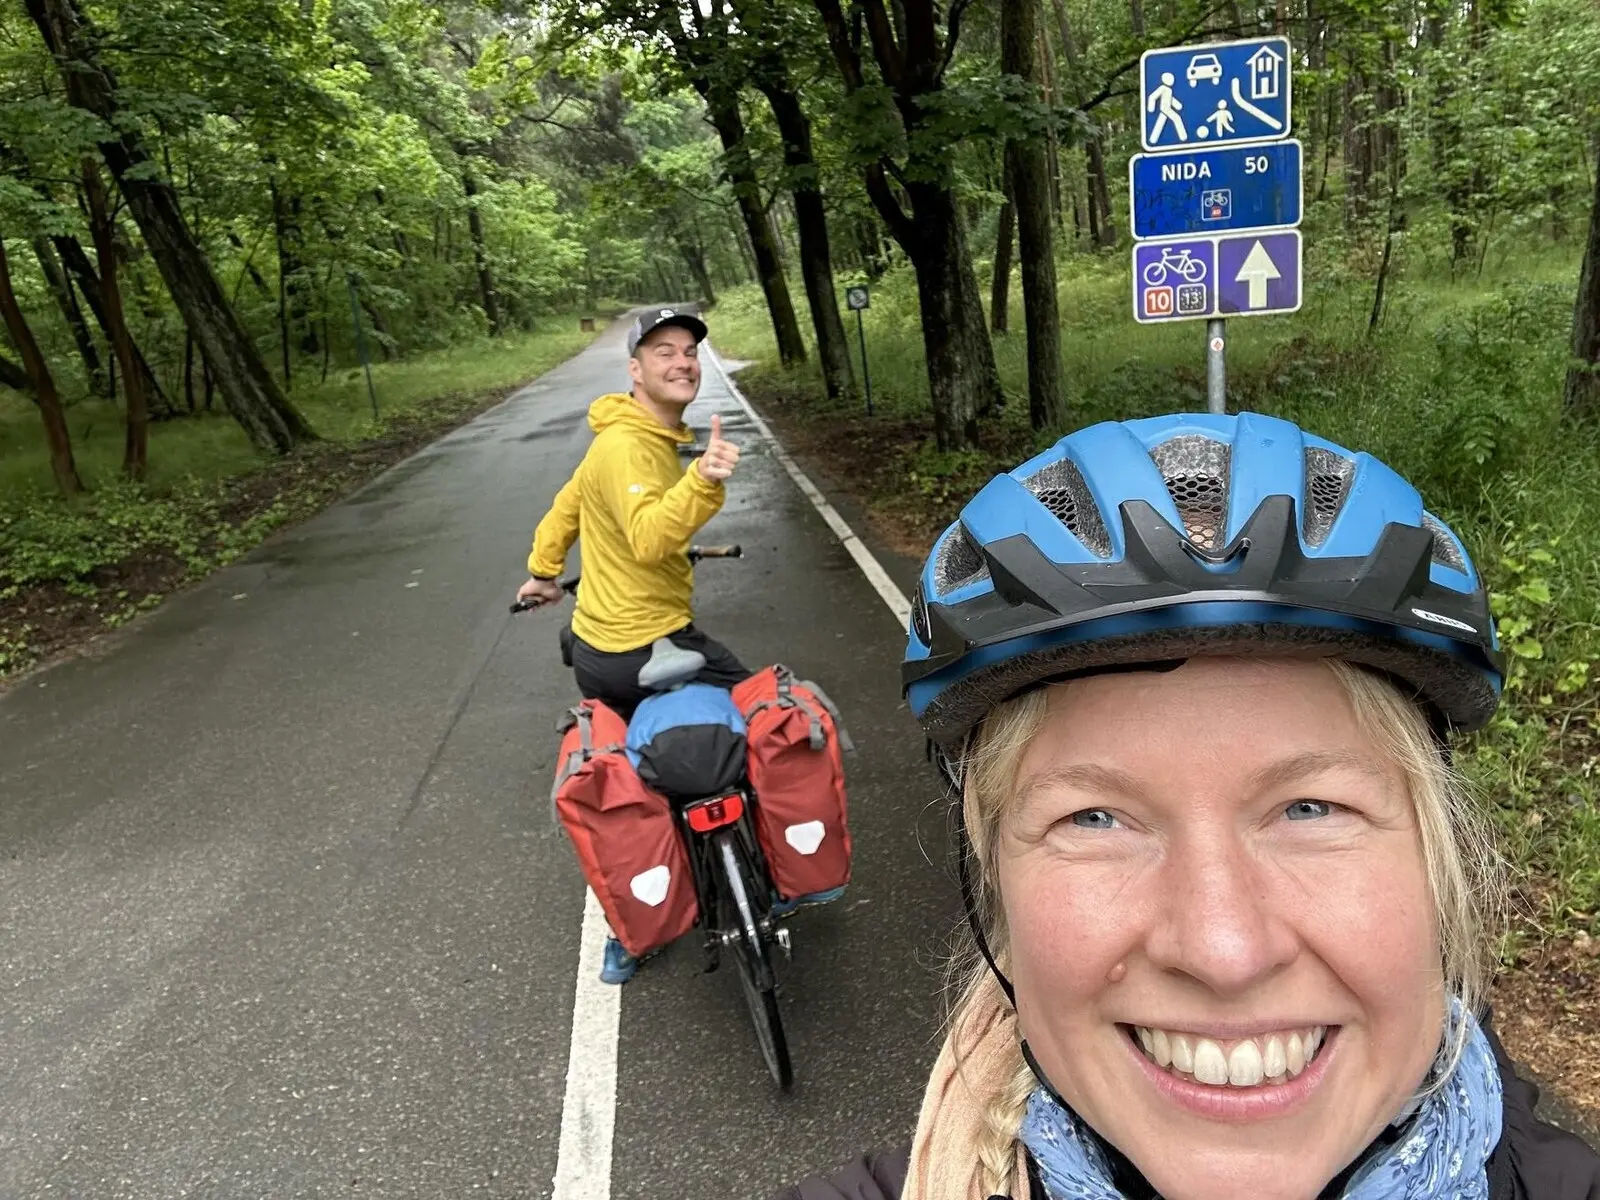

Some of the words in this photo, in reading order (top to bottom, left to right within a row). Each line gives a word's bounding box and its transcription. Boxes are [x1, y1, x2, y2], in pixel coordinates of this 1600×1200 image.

[1162, 161, 1211, 182] NIDA
[1244, 155, 1269, 174] 50
[1148, 292, 1170, 310] 10
